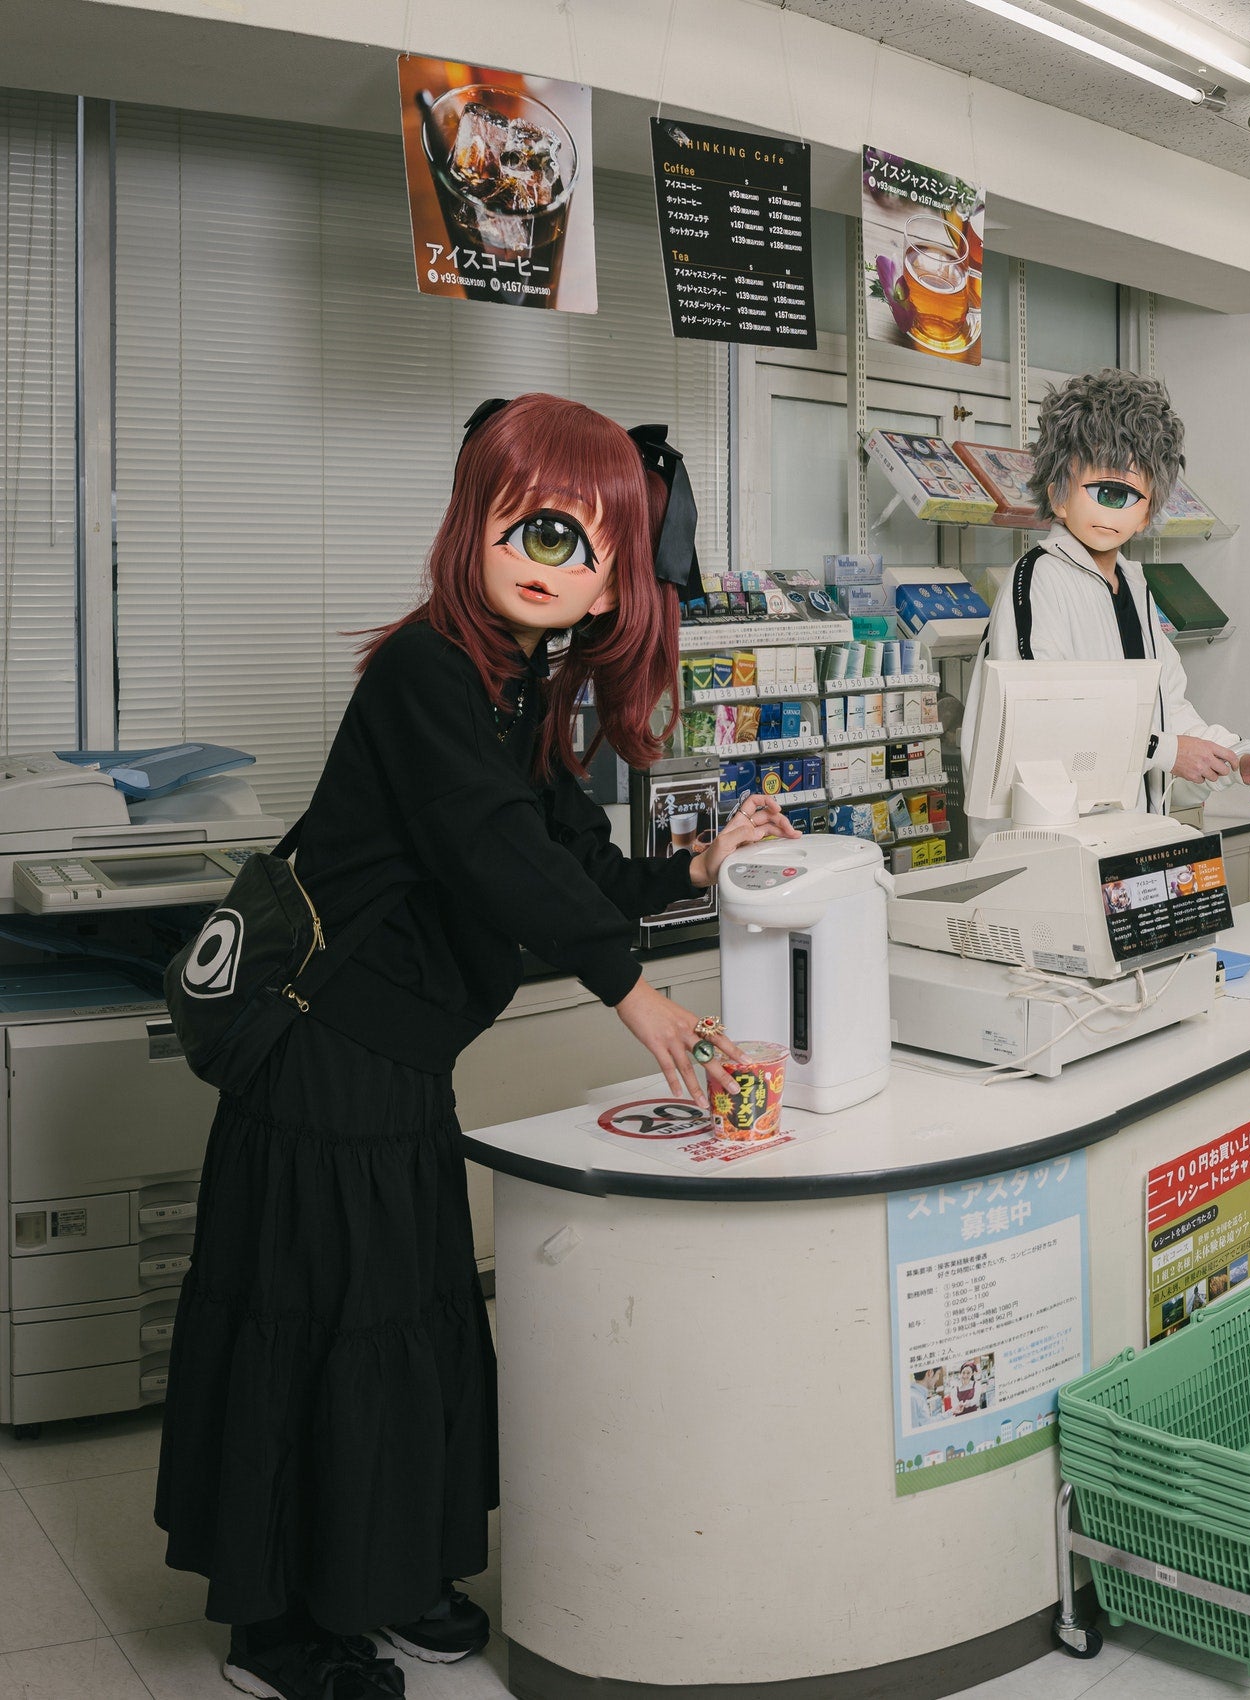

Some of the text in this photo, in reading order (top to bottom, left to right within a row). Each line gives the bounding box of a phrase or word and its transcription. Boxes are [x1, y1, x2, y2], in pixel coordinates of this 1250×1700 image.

[677, 137, 784, 165] THINKING Cafe
[664, 162, 695, 176] Coffee
[664, 179, 702, 191] アイスコーヒー
[869, 157, 977, 204] アイスジャスミンティー
[666, 195, 702, 205] ホットコーヒー
[667, 210, 710, 224] アイスカフェラテ
[669, 226, 710, 239] ホットカフェラテ
[425, 242, 550, 277] アイスコーヒー
[672, 250, 689, 262] Tea
[851, 679, 861, 687] 50
[927, 675, 936, 683] 54
[720, 688, 731, 697] 38
[740, 688, 751, 696] 39
[764, 686, 775, 694] 40
[783, 685, 793, 693] 41
[803, 683, 813, 691] 42
[833, 724, 938, 741] 19 20 21 22 23 24
[721, 746, 732, 754] 26
[742, 744, 753, 752] 27
[767, 741, 778, 749] 28
[787, 739, 798, 747] 29
[808, 737, 819, 745] 30
[916, 776, 925, 784] 11
[934, 774, 943, 782] 12
[903, 825, 929, 835] 58 59
[613, 1104, 704, 1134] 20
[907, 1157, 1071, 1220] ストアスタッフ
[960, 1200, 1032, 1241] 募集中
